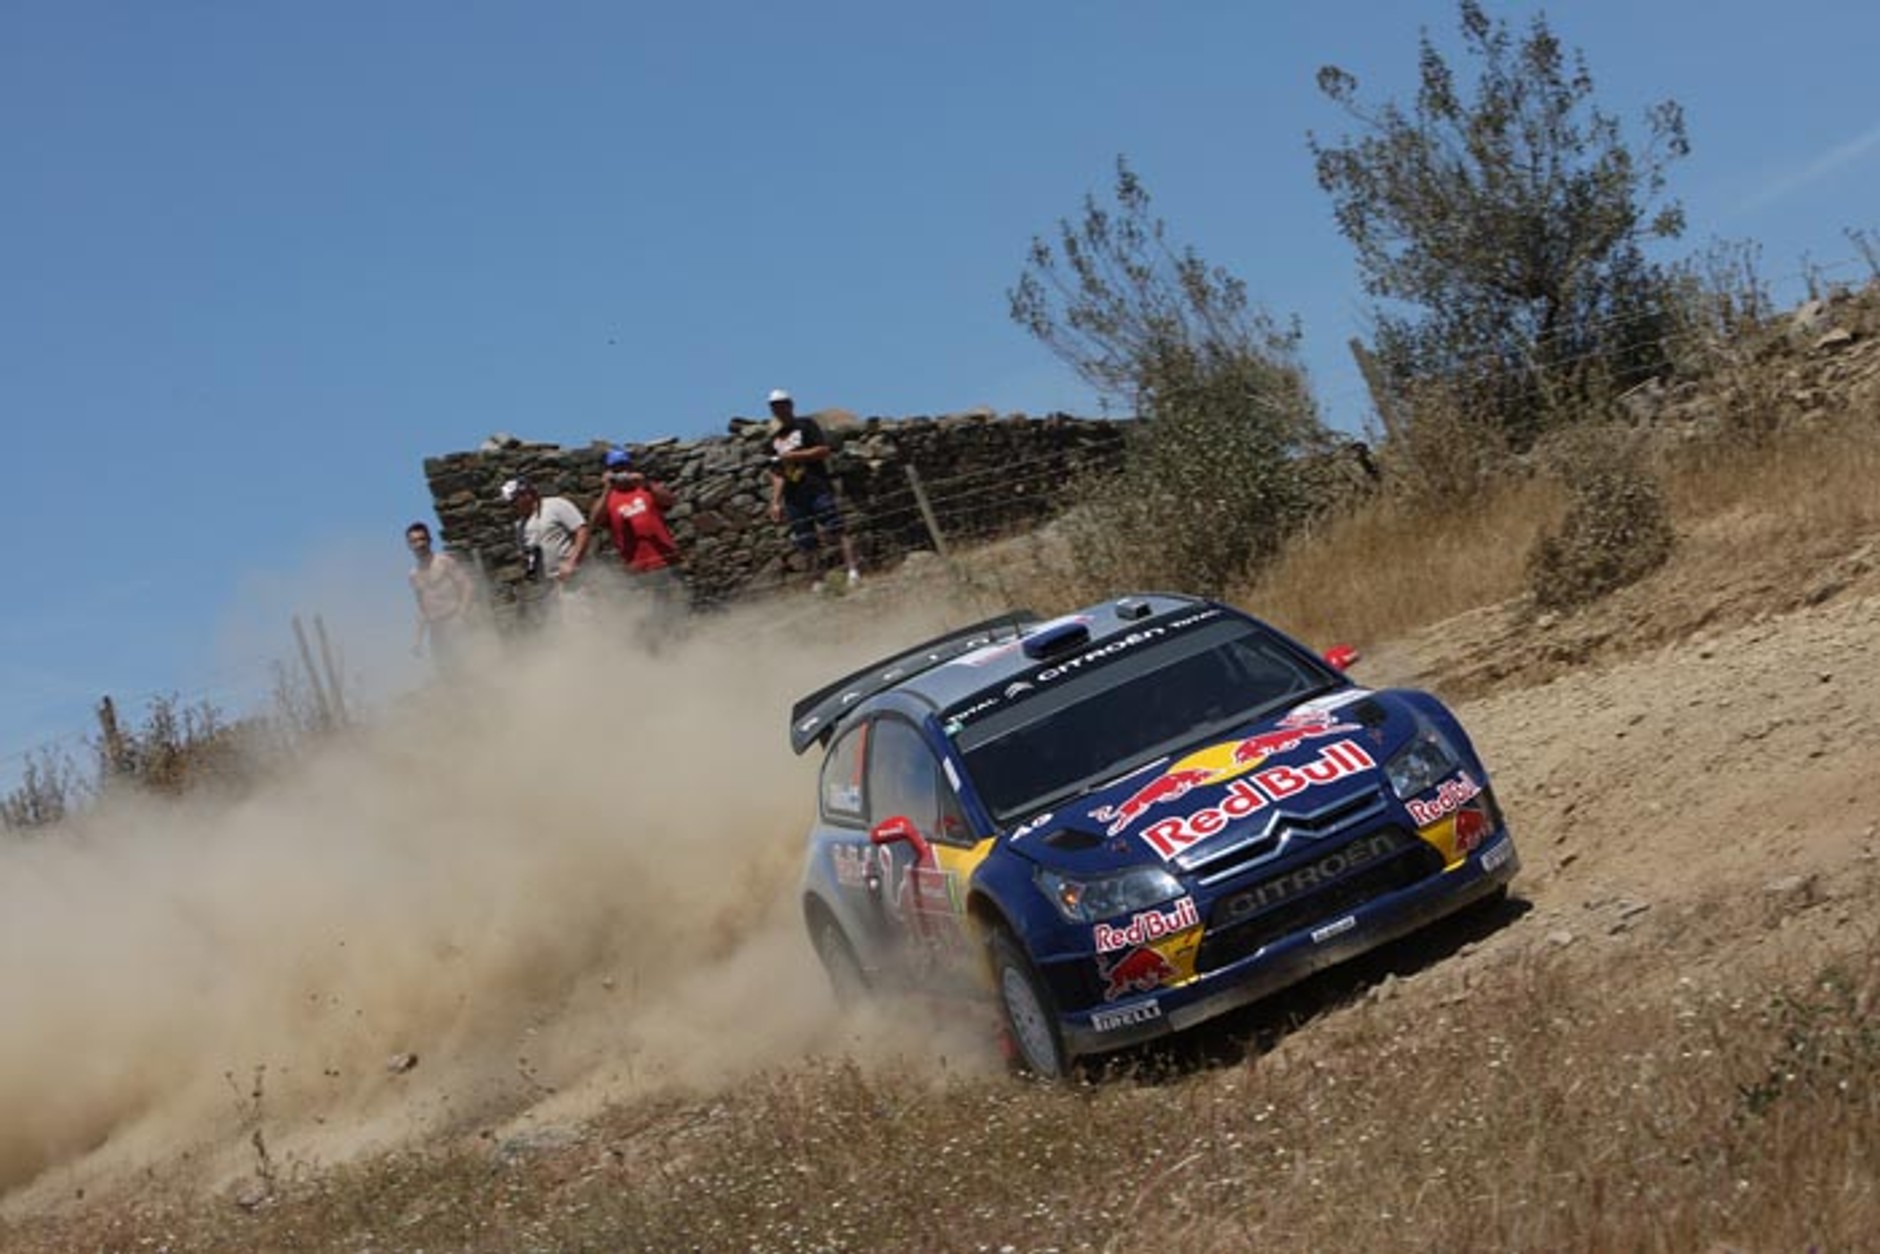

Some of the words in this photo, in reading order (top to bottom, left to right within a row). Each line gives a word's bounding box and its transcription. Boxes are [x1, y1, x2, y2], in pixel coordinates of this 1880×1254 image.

[1139, 779, 1270, 862] Red
[1250, 739, 1377, 801] Bull
[1094, 912, 1145, 953] Red
[1144, 896, 1200, 939] Bull
